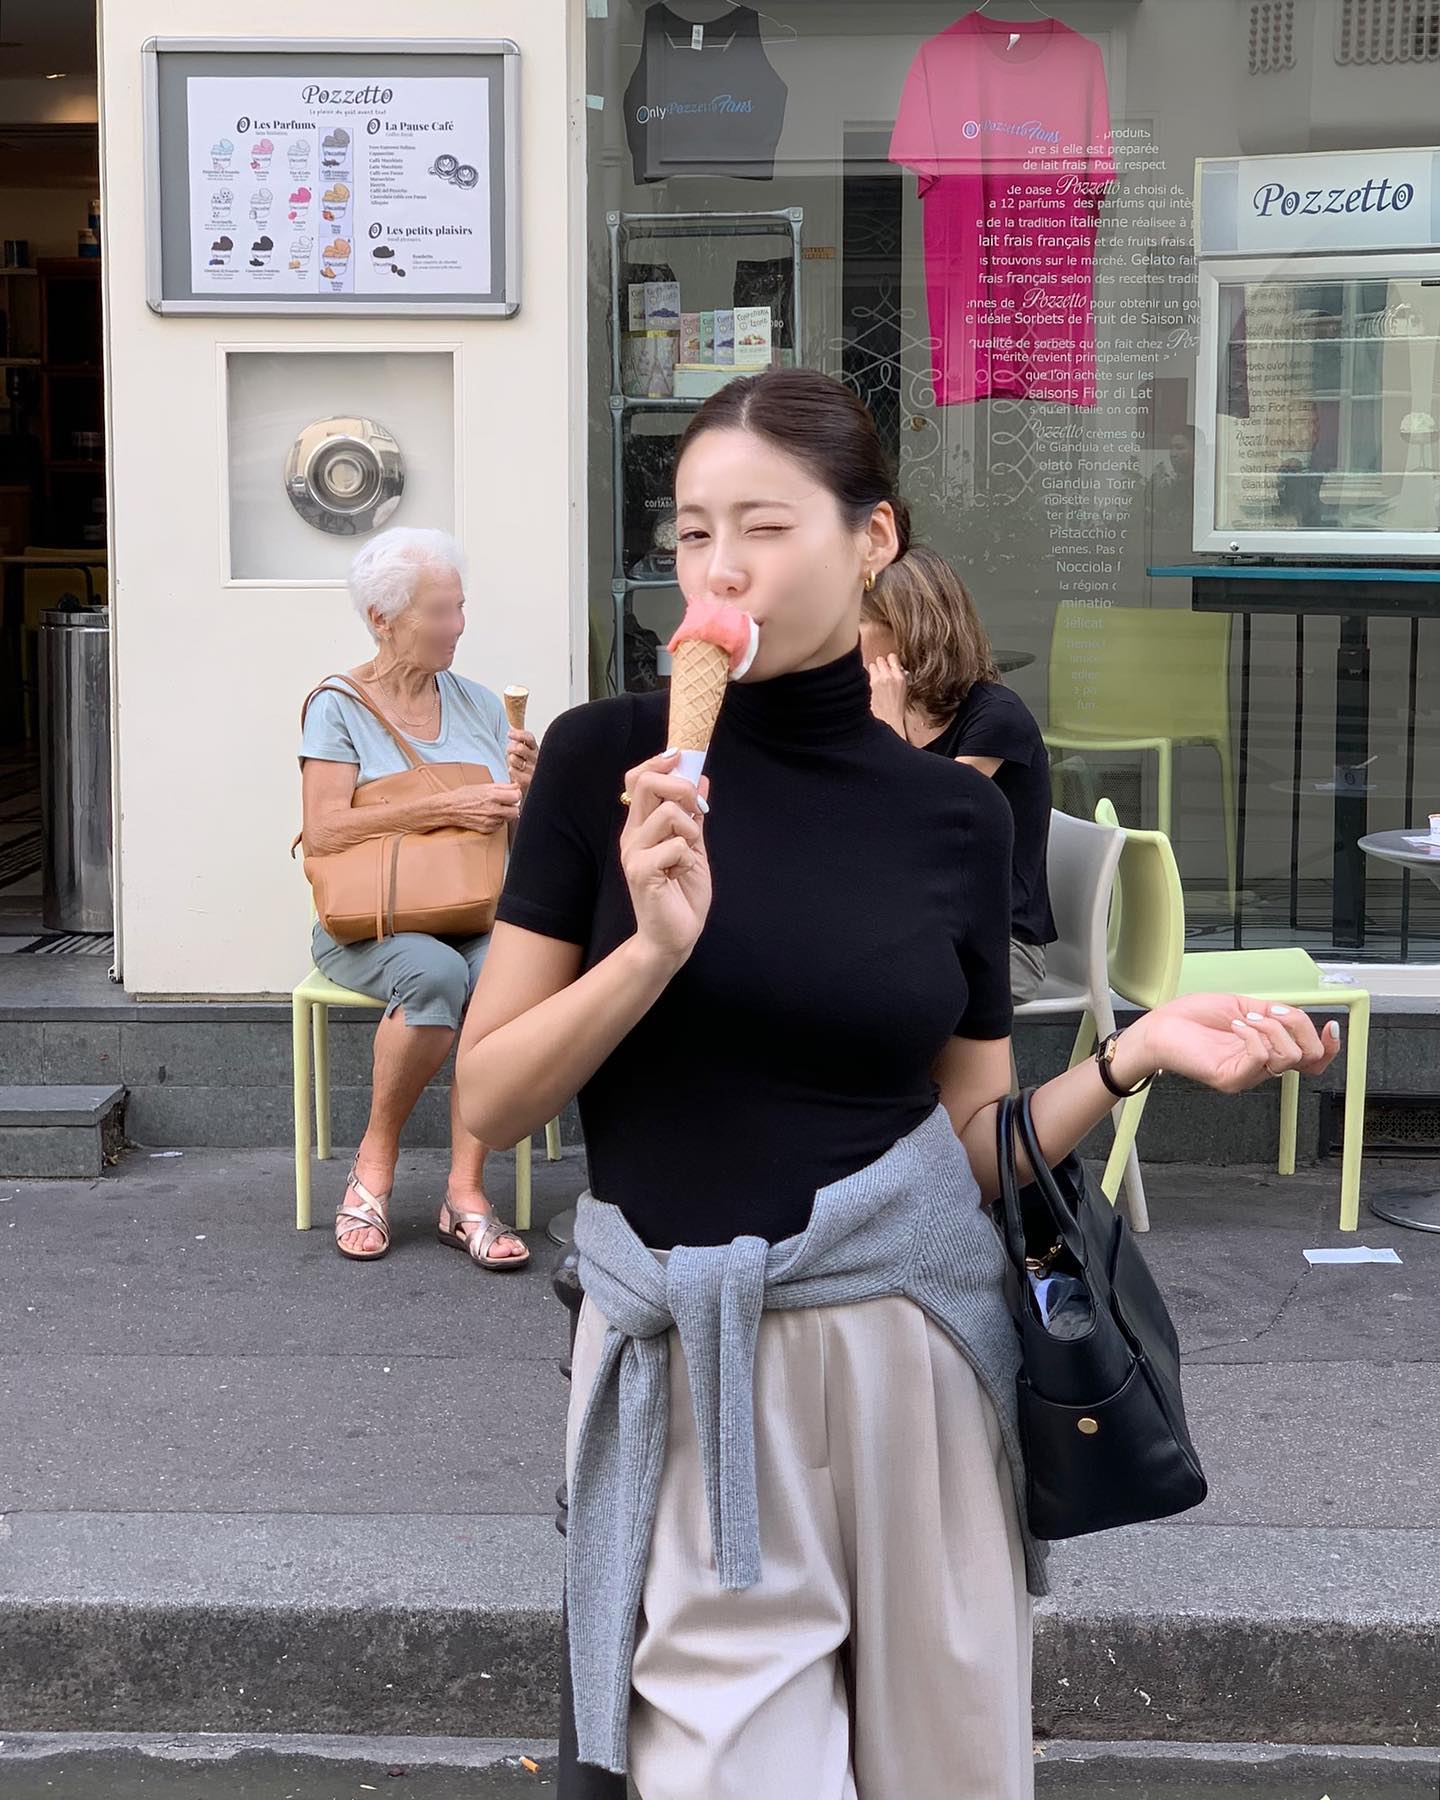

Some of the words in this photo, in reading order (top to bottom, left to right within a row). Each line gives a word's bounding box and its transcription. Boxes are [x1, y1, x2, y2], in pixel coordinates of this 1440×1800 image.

[302, 85, 393, 104] Pozzetto
[254, 120, 271, 129] Les
[273, 120, 316, 130] Parfums
[385, 121, 398, 131] La
[400, 122, 429, 133] Pause
[432, 120, 454, 131] Café
[1050, 144, 1059, 154] si
[1062, 144, 1083, 154] elle
[1086, 145, 1104, 154] est
[1107, 143, 1160, 157] preparée
[1023, 159, 1037, 169] de
[1041, 159, 1059, 169] lait
[1062, 159, 1088, 169] frais
[1094, 160, 1121, 170] Pour
[1056, 174, 1121, 196] Pozzetto
[1123, 186, 1130, 194] a
[1134, 184, 1167, 195] choisi
[1254, 178, 1414, 217] Pozzetto
[1000, 198, 1015, 208] 12
[1018, 197, 1066, 211] parfums
[1073, 197, 1095, 208] des
[1097, 197, 1145, 211] parfums
[1149, 198, 1167, 212] qui
[986, 217, 1001, 228] de
[1004, 217, 1015, 228] la
[1018, 217, 1066, 228] tradition
[1070, 215, 1129, 228] italienne
[387, 226, 404, 235] Les
[406, 225, 433, 237] petits
[435, 225, 473, 237] plaisirs
[978, 235, 1000, 247] lait
[1004, 235, 1033, 247] frais
[1037, 235, 1092, 250] français
[1094, 237, 1106, 247] et
[1109, 236, 1125, 247] de
[1127, 236, 1157, 247] fruits
[1160, 236, 1186, 247] frais
[992, 255, 1042, 266] trouvons
[1045, 256, 1063, 266] sur
[1067, 254, 1077, 266] le
[1081, 253, 1127, 266] marché.
[1131, 253, 1177, 266] Gelato
[1179, 254, 1198, 266] fait
[978, 273, 1004, 284] frais
[1006, 271, 1058, 287] français
[1060, 274, 1092, 284] selon
[1094, 274, 1115, 284] des
[1118, 275, 1166, 284] recettes
[1000, 298, 1015, 308] de
[1022, 287, 1088, 309] Pozzetto
[1090, 299, 1117, 311] pour
[1119, 297, 1161, 309] obtenir
[1164, 299, 1179, 308] un
[977, 312, 1012, 324] idéale
[1014, 312, 1065, 324] Sorbets
[1067, 313, 1083, 324] de
[1086, 311, 1116, 324] Fruit
[1120, 312, 1137, 324] de
[1141, 311, 1184, 325] Saison
[1016, 337, 1031, 349] de
[1034, 337, 1076, 349] sorbets
[1079, 337, 1110, 352] qu'on
[1114, 337, 1133, 349] fait
[1136, 337, 1163, 349] chez
[992, 350, 1029, 362] mérite
[1032, 351, 1072, 362] revient
[1075, 351, 1159, 364] principalement
[1025, 371, 1047, 381] que
[1050, 370, 1071, 380] l'on
[1074, 369, 1113, 380] achète
[1116, 371, 1135, 380] sur
[1138, 370, 1154, 380] les
[1028, 387, 1079, 399] saisons
[1083, 387, 1109, 399] Fior
[1113, 387, 1126, 399] di
[1130, 387, 1153, 399] Lat
[1039, 404, 1071, 419] qu'en
[1075, 404, 1103, 415] Italie
[1106, 406, 1122, 415] on
[1086, 427, 1128, 439] crèmes
[1130, 430, 1145, 439] ou
[1035, 441, 1046, 452] le
[1103, 442, 1114, 452] et
[1118, 441, 1141, 452] cela
[1040, 458, 1073, 471] olato
[1044, 494, 1090, 505] noisette
[1047, 510, 1063, 520] ter
[1066, 509, 1100, 520] d'être
[1103, 510, 1113, 520] la
[1049, 527, 1117, 540] Pistacchio
[1096, 544, 1116, 555] Pas
[1056, 560, 1113, 574] Nocciola
[1060, 580, 1070, 591] la
[1073, 578, 1109, 593] région
